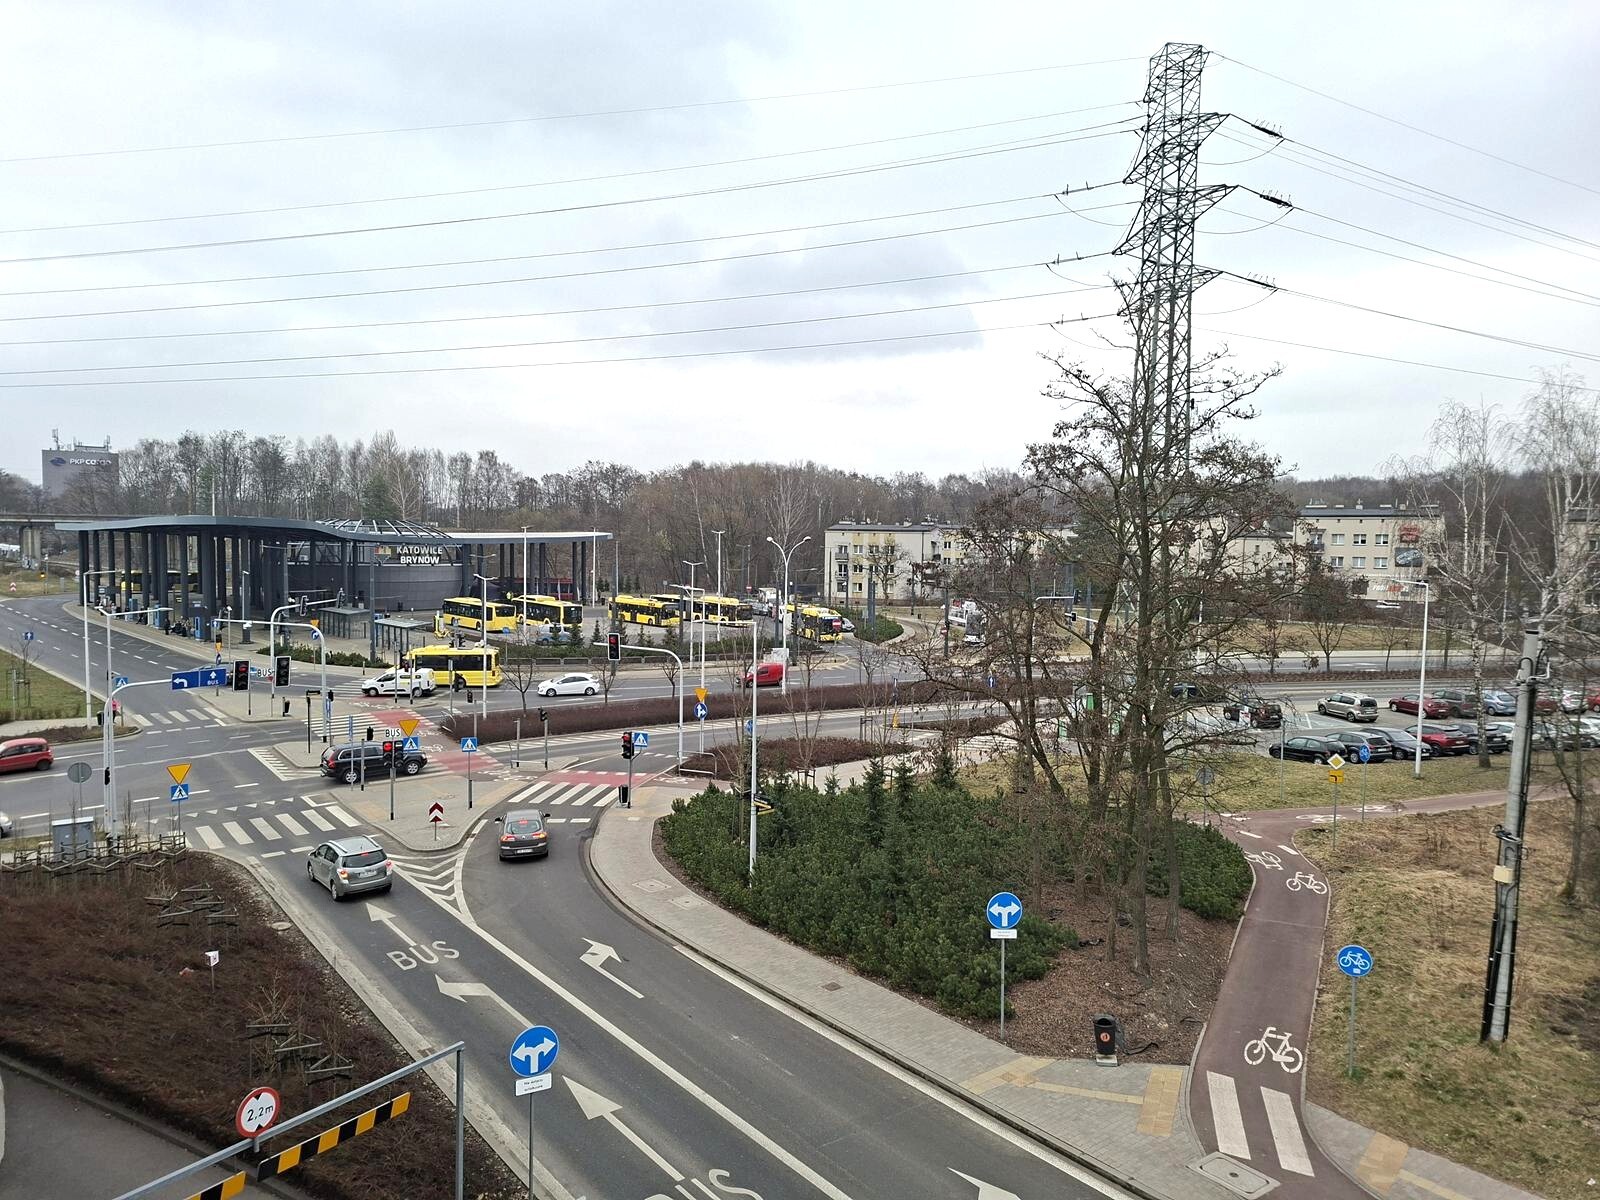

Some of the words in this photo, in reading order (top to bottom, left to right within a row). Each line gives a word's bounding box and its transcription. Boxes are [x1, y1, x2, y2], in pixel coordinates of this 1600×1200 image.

[396, 546, 443, 555] KATOWICE
[400, 554, 440, 564] BRYNÓW
[257, 668, 273, 677] BUS
[385, 728, 401, 738] BUS
[386, 940, 460, 971] BUS
